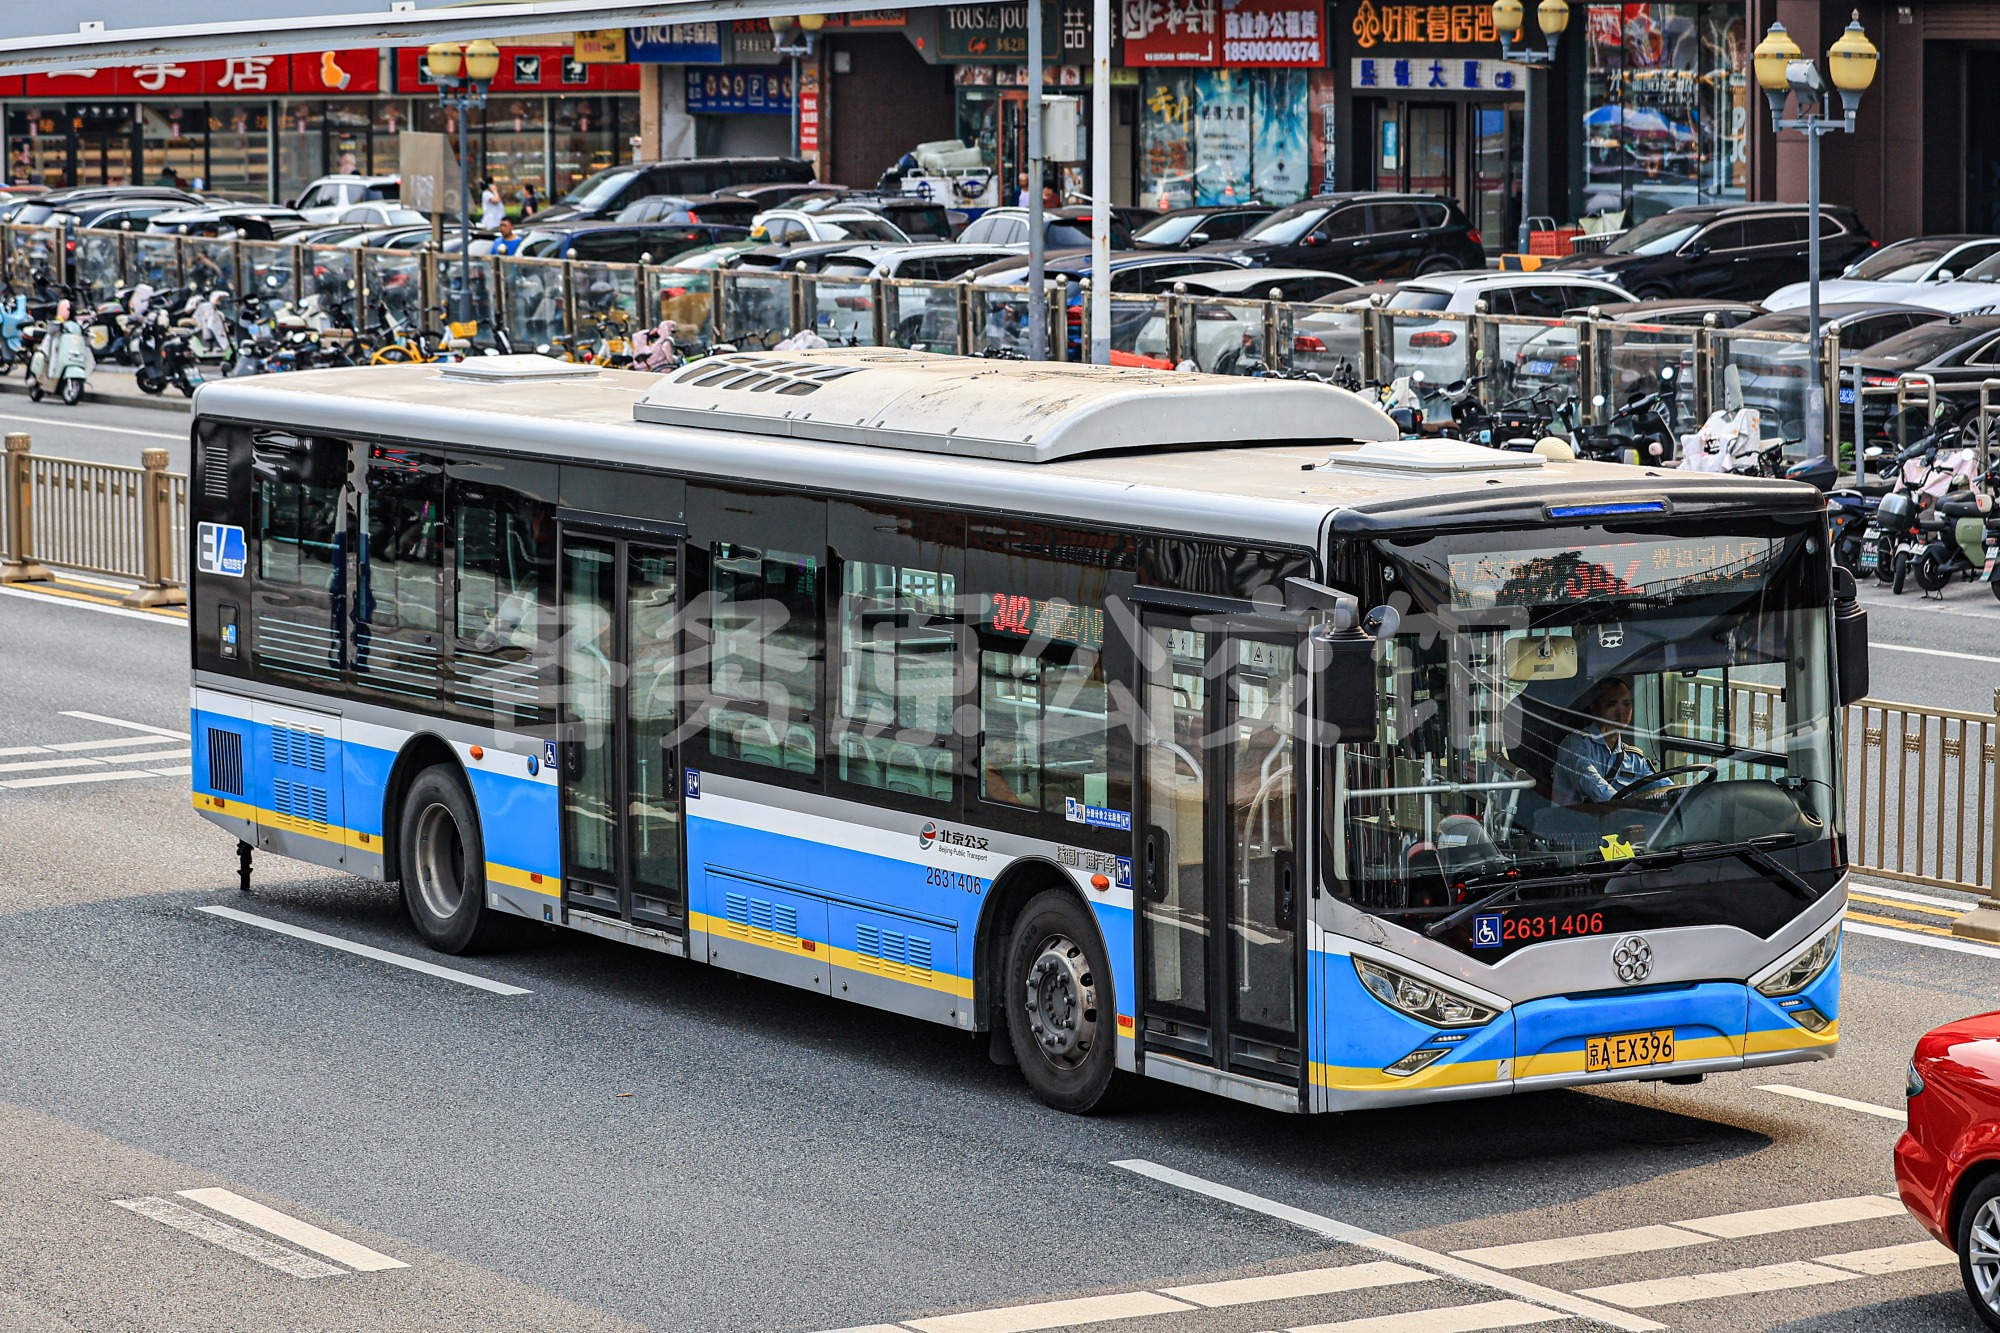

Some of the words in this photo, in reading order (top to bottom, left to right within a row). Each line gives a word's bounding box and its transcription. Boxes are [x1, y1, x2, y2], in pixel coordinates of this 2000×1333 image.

[947, 7, 984, 30] TOUS
[1000, 7, 1029, 33] JOU
[1225, 11, 1319, 39] 商业办公租赁
[1224, 41, 1321, 62] 18500300374
[993, 592, 1031, 635] 342
[938, 844, 953, 857] Beijing
[953, 847, 966, 858] Public
[967, 850, 988, 862] Transport
[939, 829, 990, 852] 北京公交
[1056, 845, 1116, 874] 珠海广通汽车
[926, 866, 982, 895] 2631406
[1503, 912, 1604, 940] 2631406
